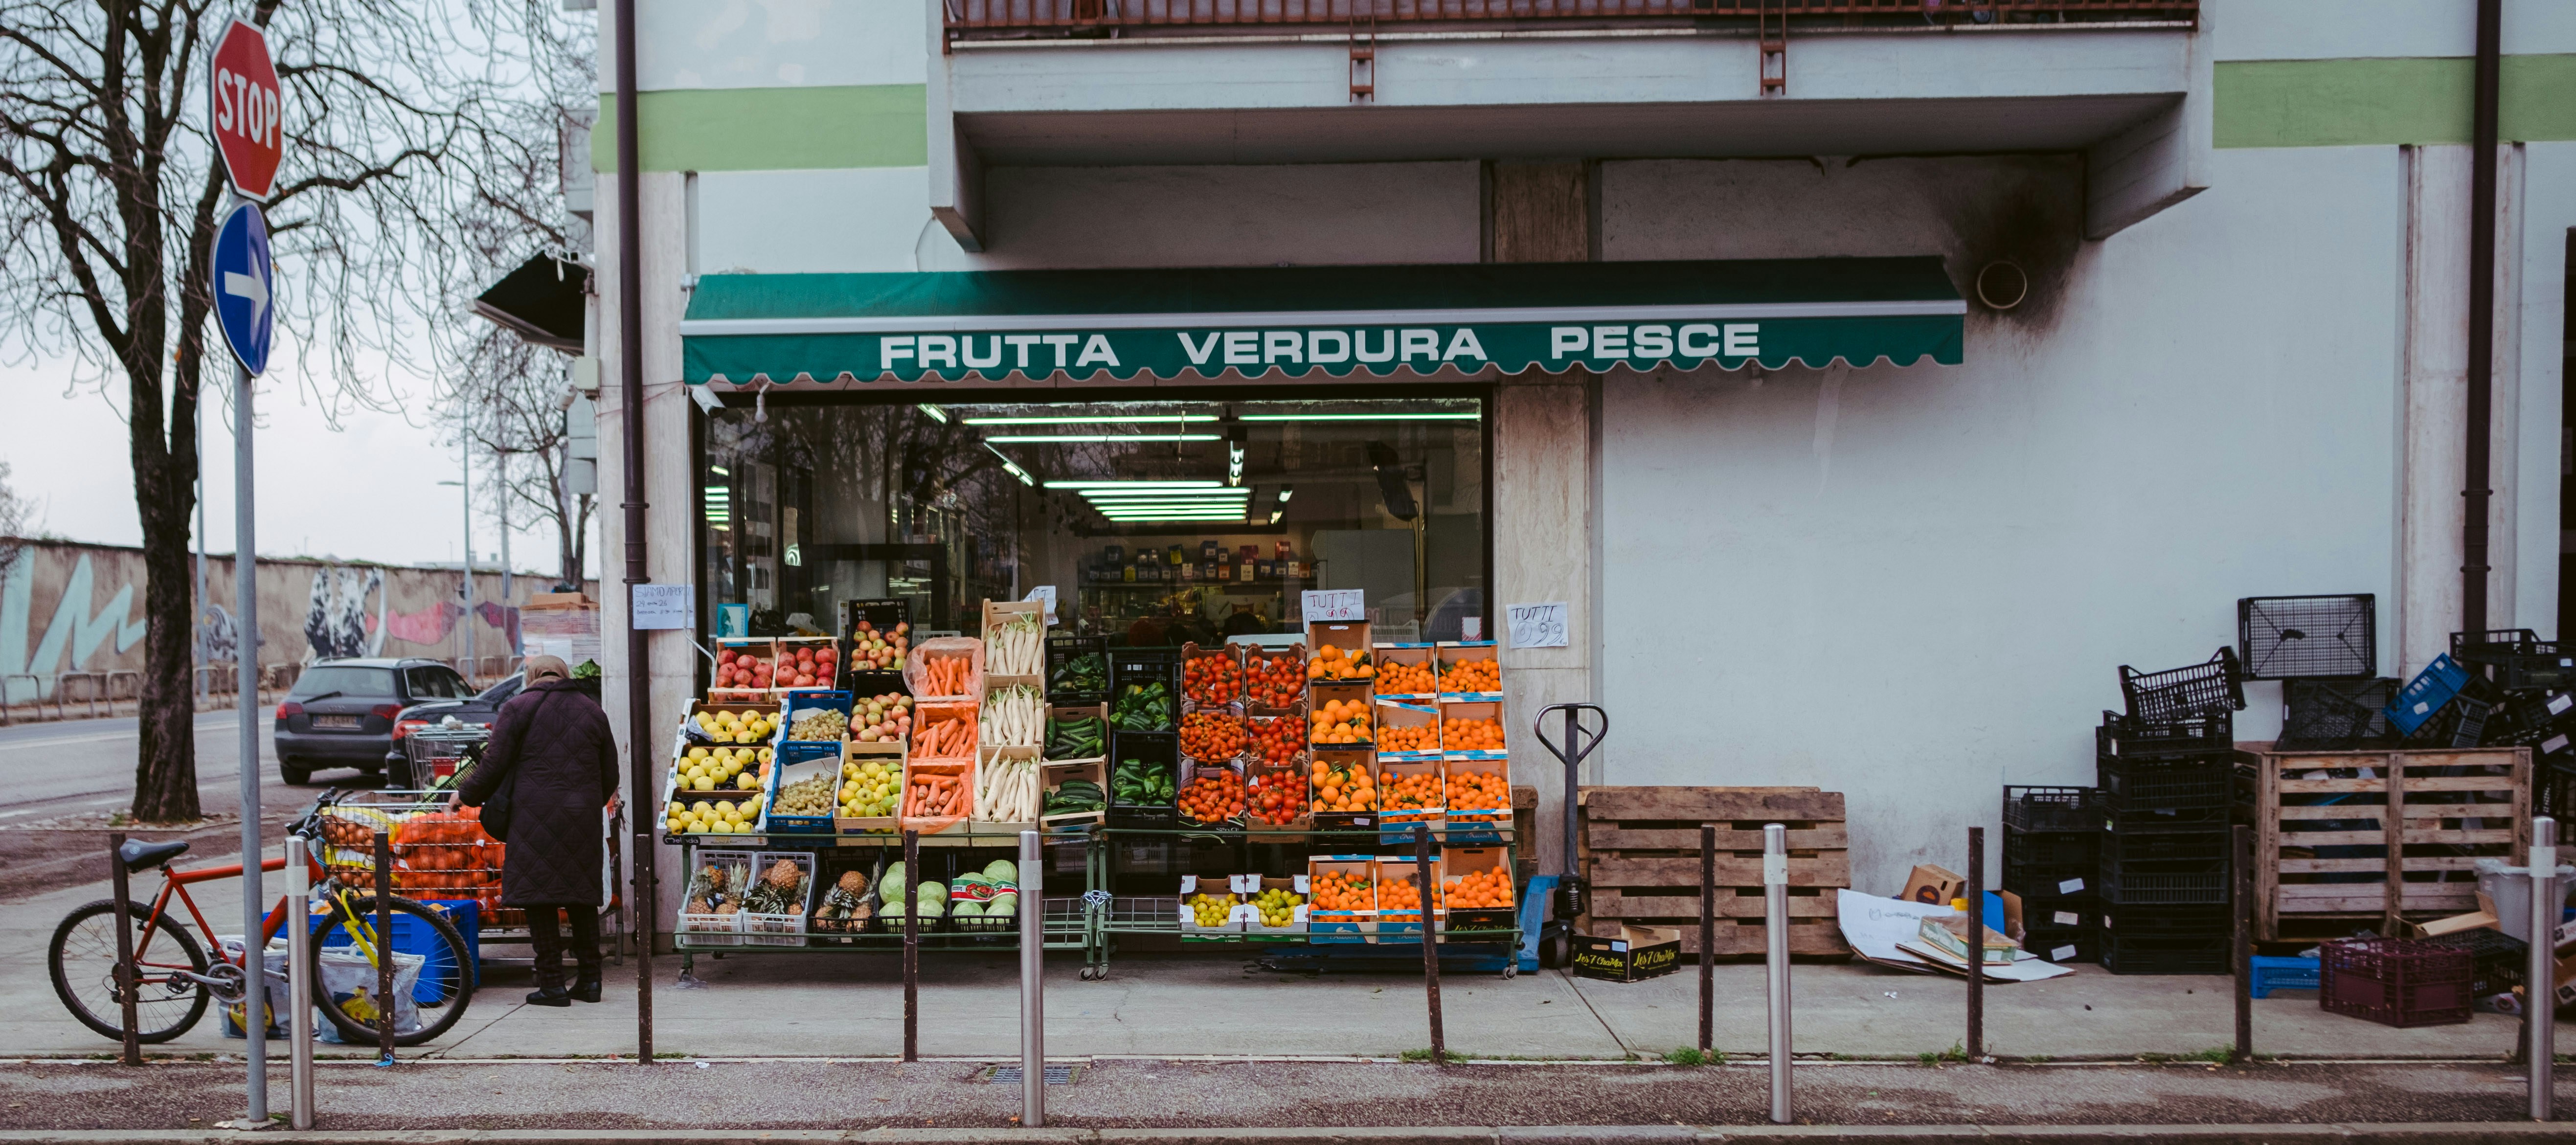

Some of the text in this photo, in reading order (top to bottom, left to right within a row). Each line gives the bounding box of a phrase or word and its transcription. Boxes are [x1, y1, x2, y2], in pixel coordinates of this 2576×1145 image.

[218, 68, 278, 149] STOP
[881, 324, 1760, 369] FRUTTA VERDURA PESCE
[635, 587, 690, 597] SIAMO APERI
[1308, 592, 1361, 608] TUTTI
[1511, 606, 1558, 622] TUTTI
[1575, 953, 1589, 966] Les
[1590, 955, 1597, 964] 7
[1633, 952, 1647, 969] Les
[1648, 951, 1653, 965] 7
